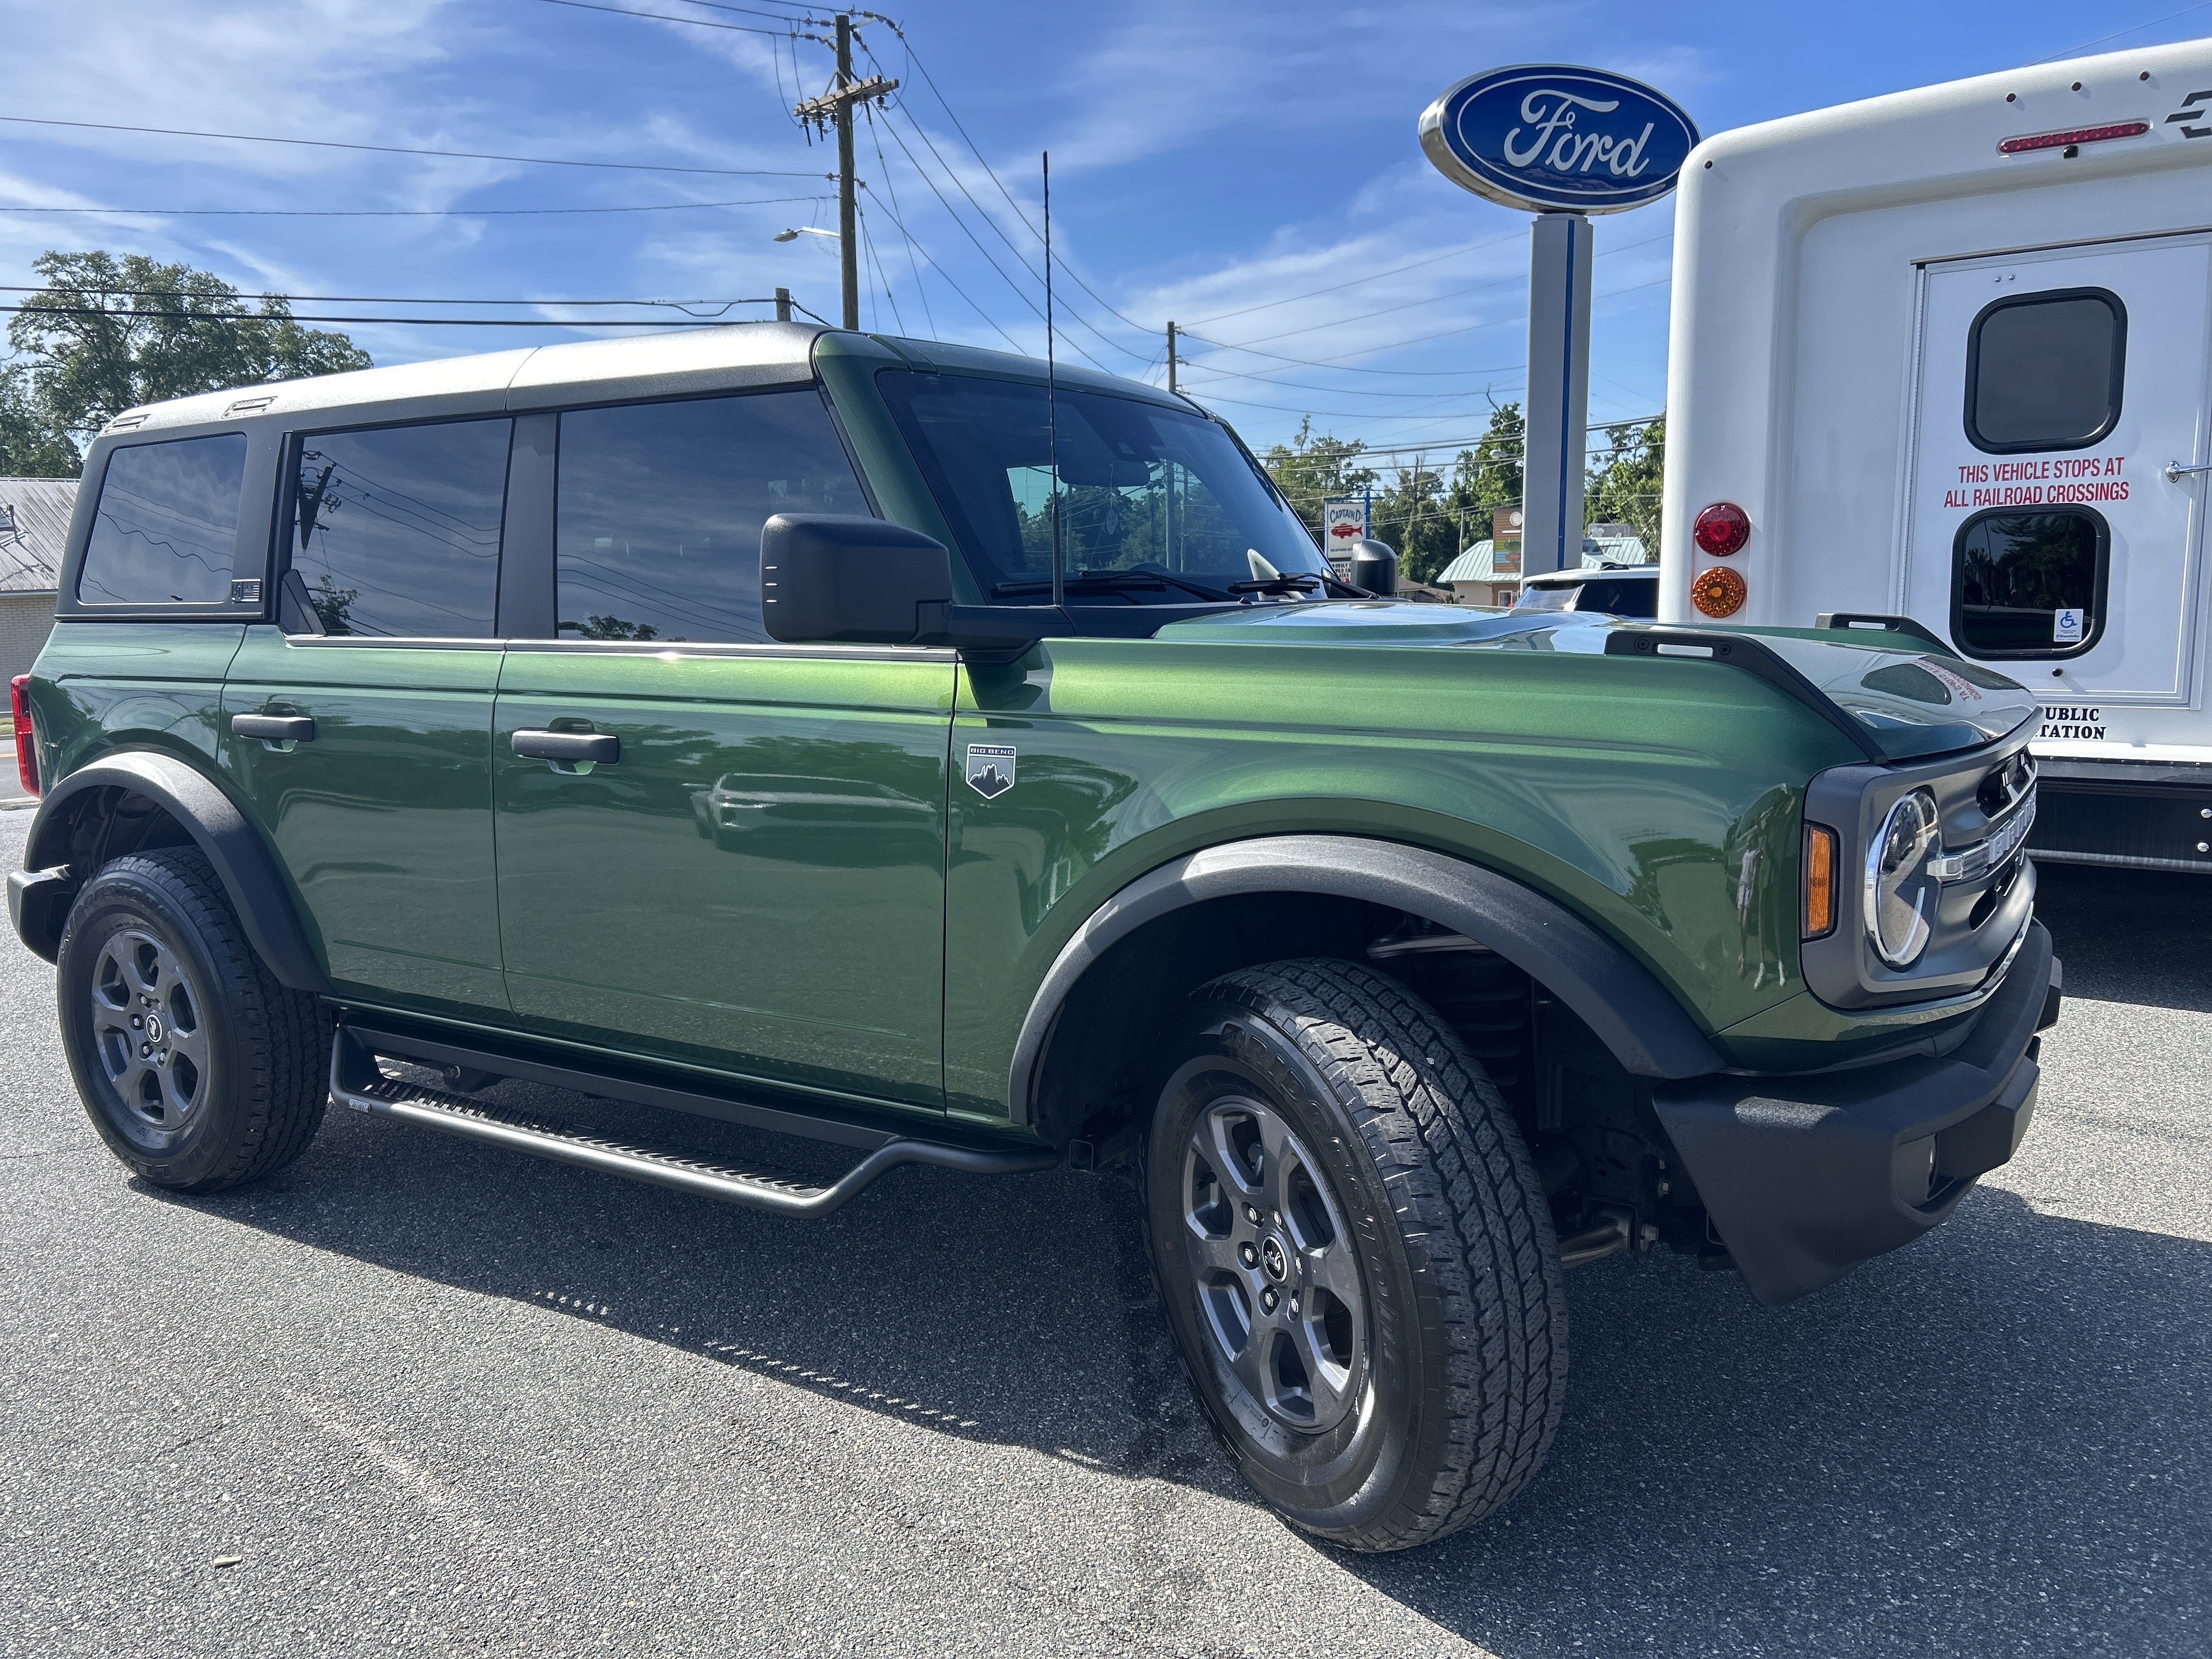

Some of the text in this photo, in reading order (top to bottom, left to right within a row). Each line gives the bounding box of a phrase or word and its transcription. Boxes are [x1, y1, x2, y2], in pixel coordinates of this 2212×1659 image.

[1504, 89, 1655, 177] Ford
[1958, 456, 2125, 484] THIS VEHICLE STOPS AT
[1943, 481, 2130, 508] ALL RAILROAD CROSSINGS
[1330, 509, 1356, 523] CAPTAIN
[2044, 707, 2100, 722] UBLIC
[2039, 724, 2107, 740] TATION
